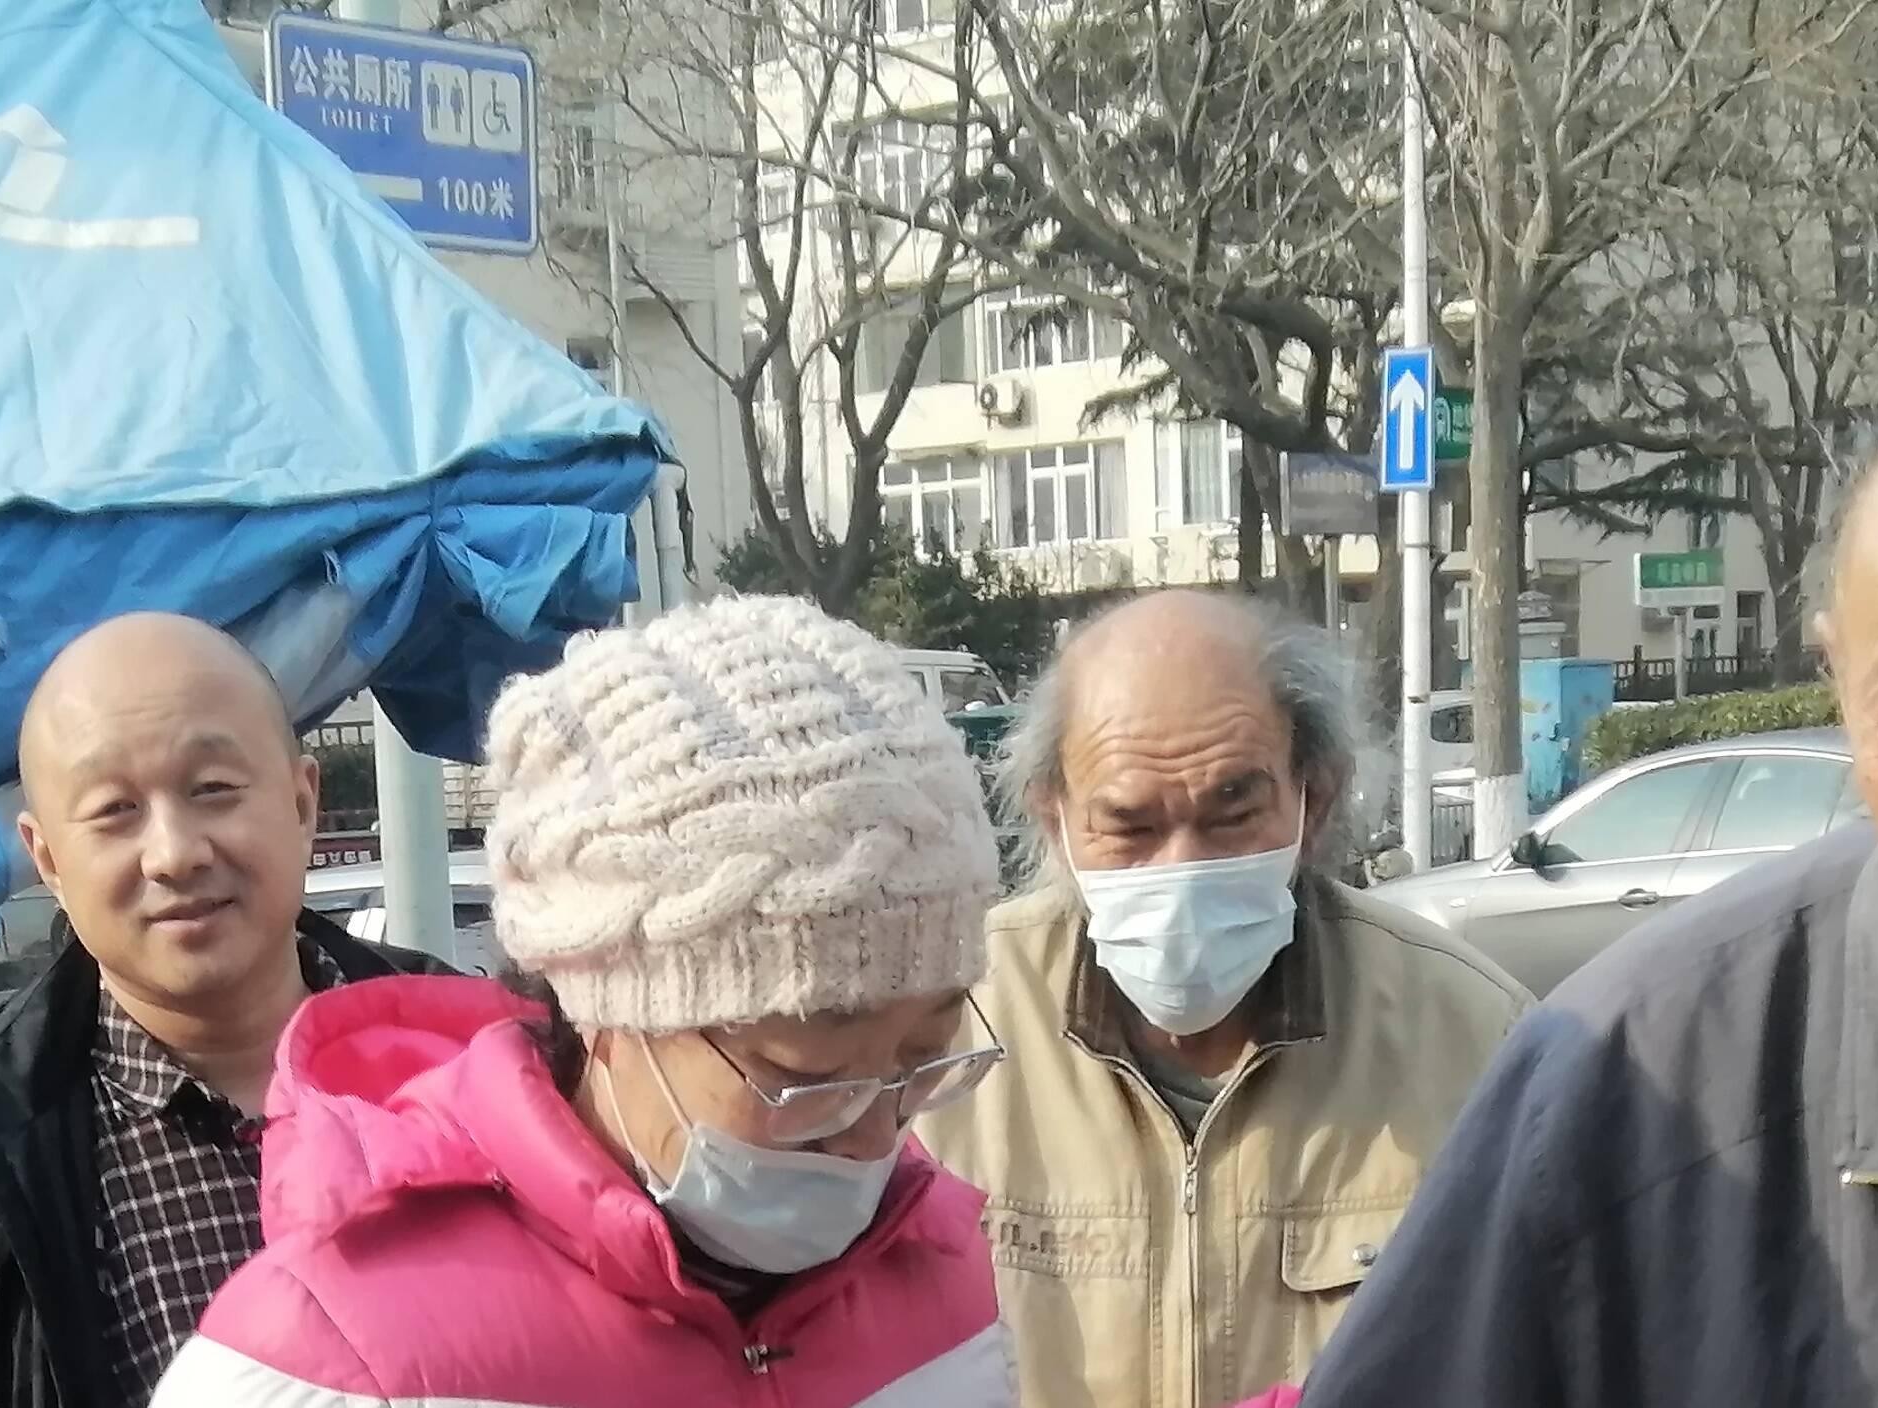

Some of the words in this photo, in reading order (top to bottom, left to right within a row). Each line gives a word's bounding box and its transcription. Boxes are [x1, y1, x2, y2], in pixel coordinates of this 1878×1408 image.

[289, 45, 412, 112] 公共厕所
[438, 175, 515, 221] 100米
